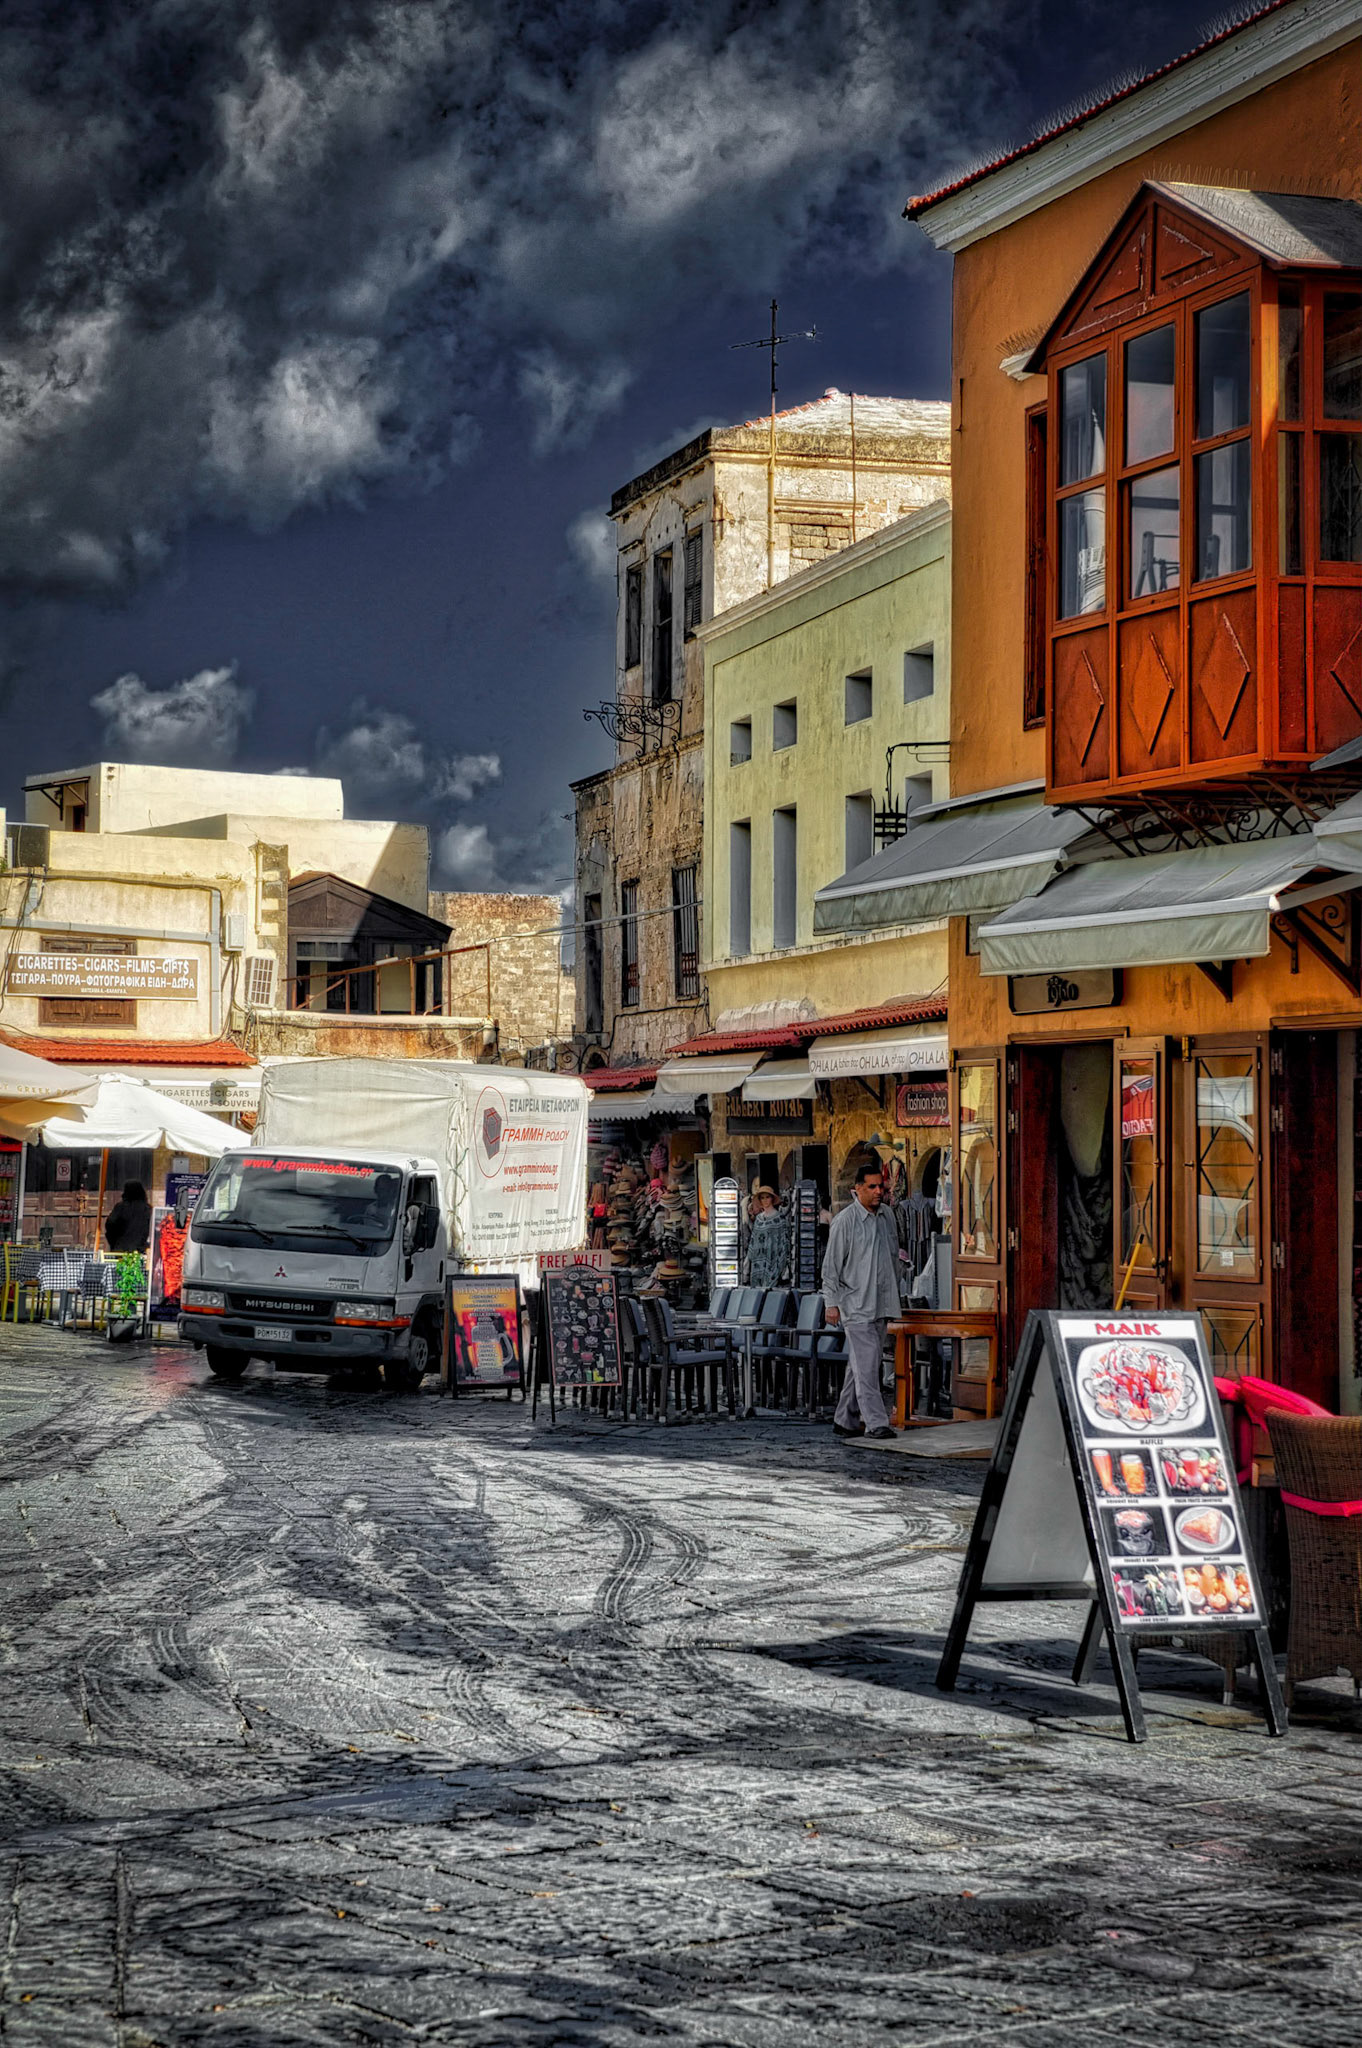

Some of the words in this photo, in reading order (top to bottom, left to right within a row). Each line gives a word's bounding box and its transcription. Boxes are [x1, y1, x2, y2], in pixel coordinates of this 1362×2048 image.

[509, 1099, 540, 1113] ΕΤΑΙΡΕΙΑ
[541, 1099, 580, 1113] ΜΕΤΑΦΟΡΩΝ
[907, 1093, 931, 1111] fashion
[931, 1093, 947, 1113] shop
[501, 1127, 544, 1142] ΓΡΑΜΜΗ
[545, 1130, 570, 1142] ΡΟΔΟΥ
[242, 1158, 375, 1178] www.grammirodou.gr
[503, 1162, 559, 1177] www.grammirodou.gr
[540, 1254, 568, 1269] FREE
[245, 1299, 315, 1312] MITSUBISHI
[1095, 1323, 1161, 1336] MAIK
